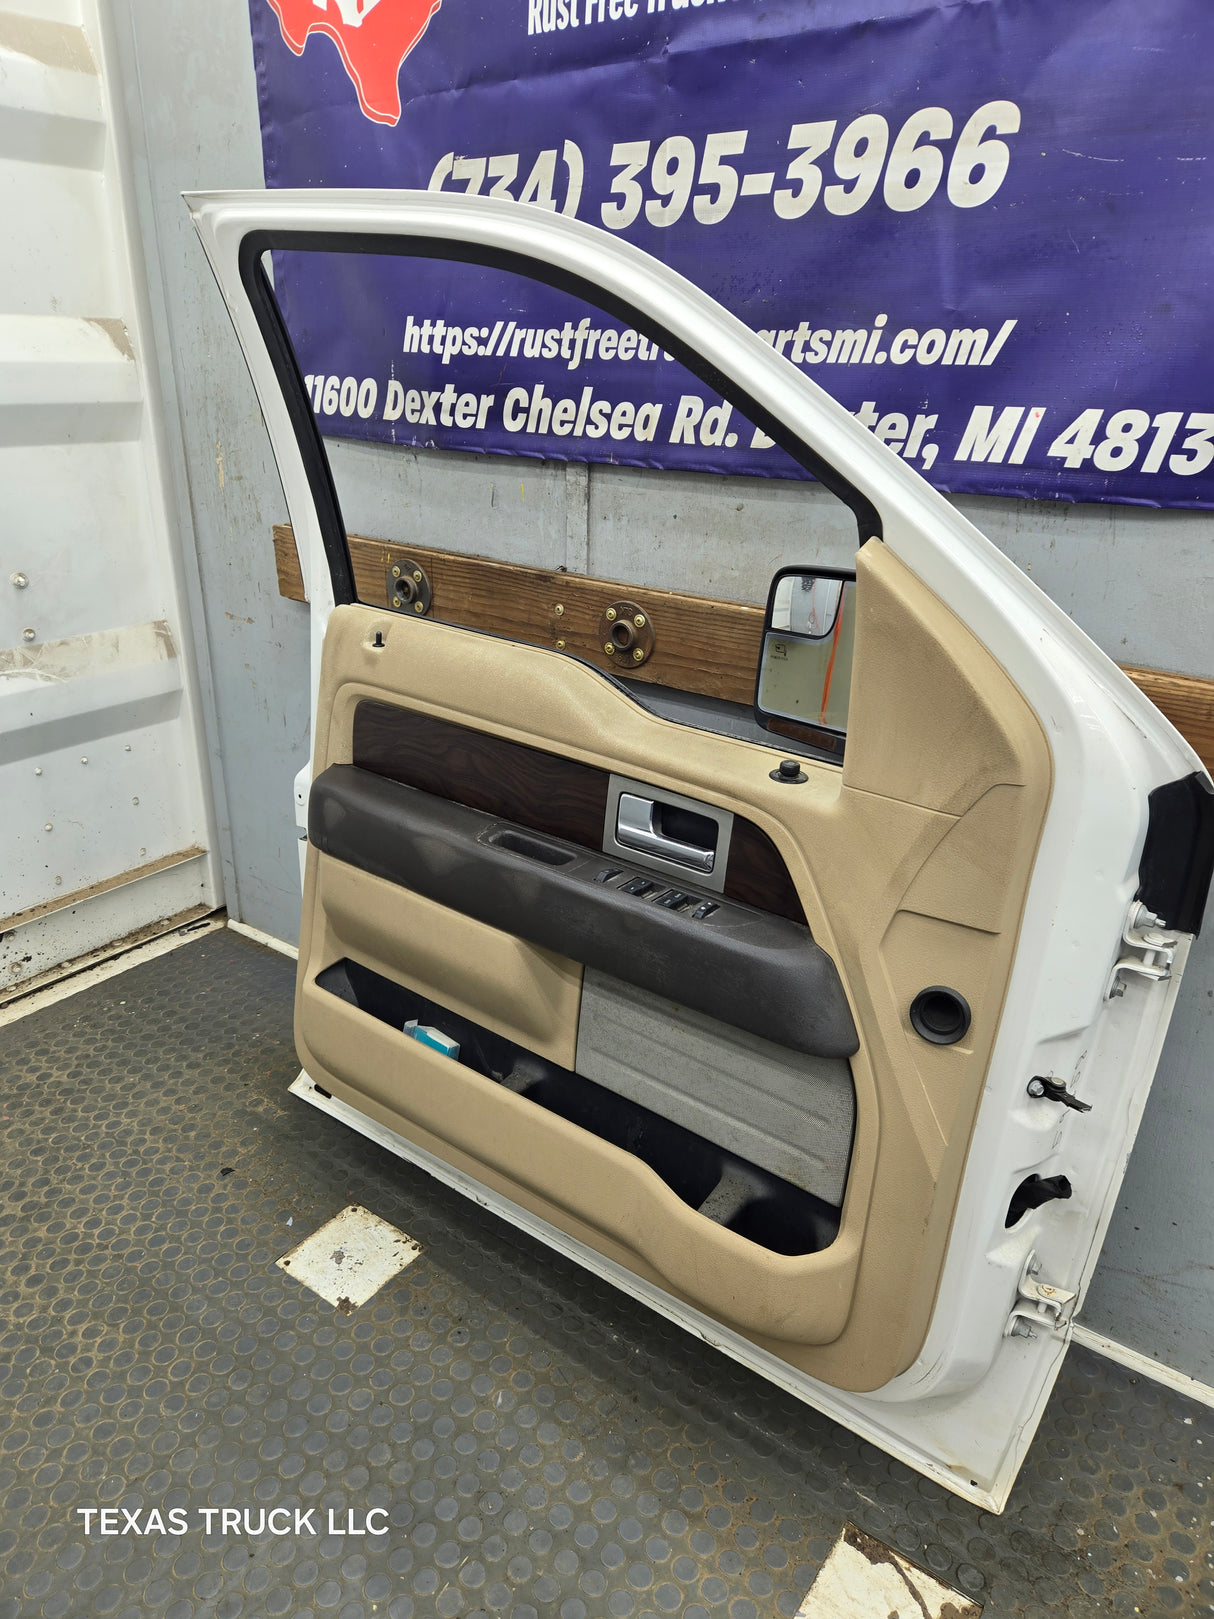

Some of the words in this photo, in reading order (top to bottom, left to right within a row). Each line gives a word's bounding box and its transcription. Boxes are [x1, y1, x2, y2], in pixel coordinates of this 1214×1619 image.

[528, 0, 580, 35] Rust
[600, 100, 1022, 230] 395-3966
[304, 374, 378, 419] 11600
[382, 379, 495, 430] Dexter
[502, 384, 664, 442] Chelsea
[669, 395, 739, 448] Rd.
[953, 405, 1047, 465] MI
